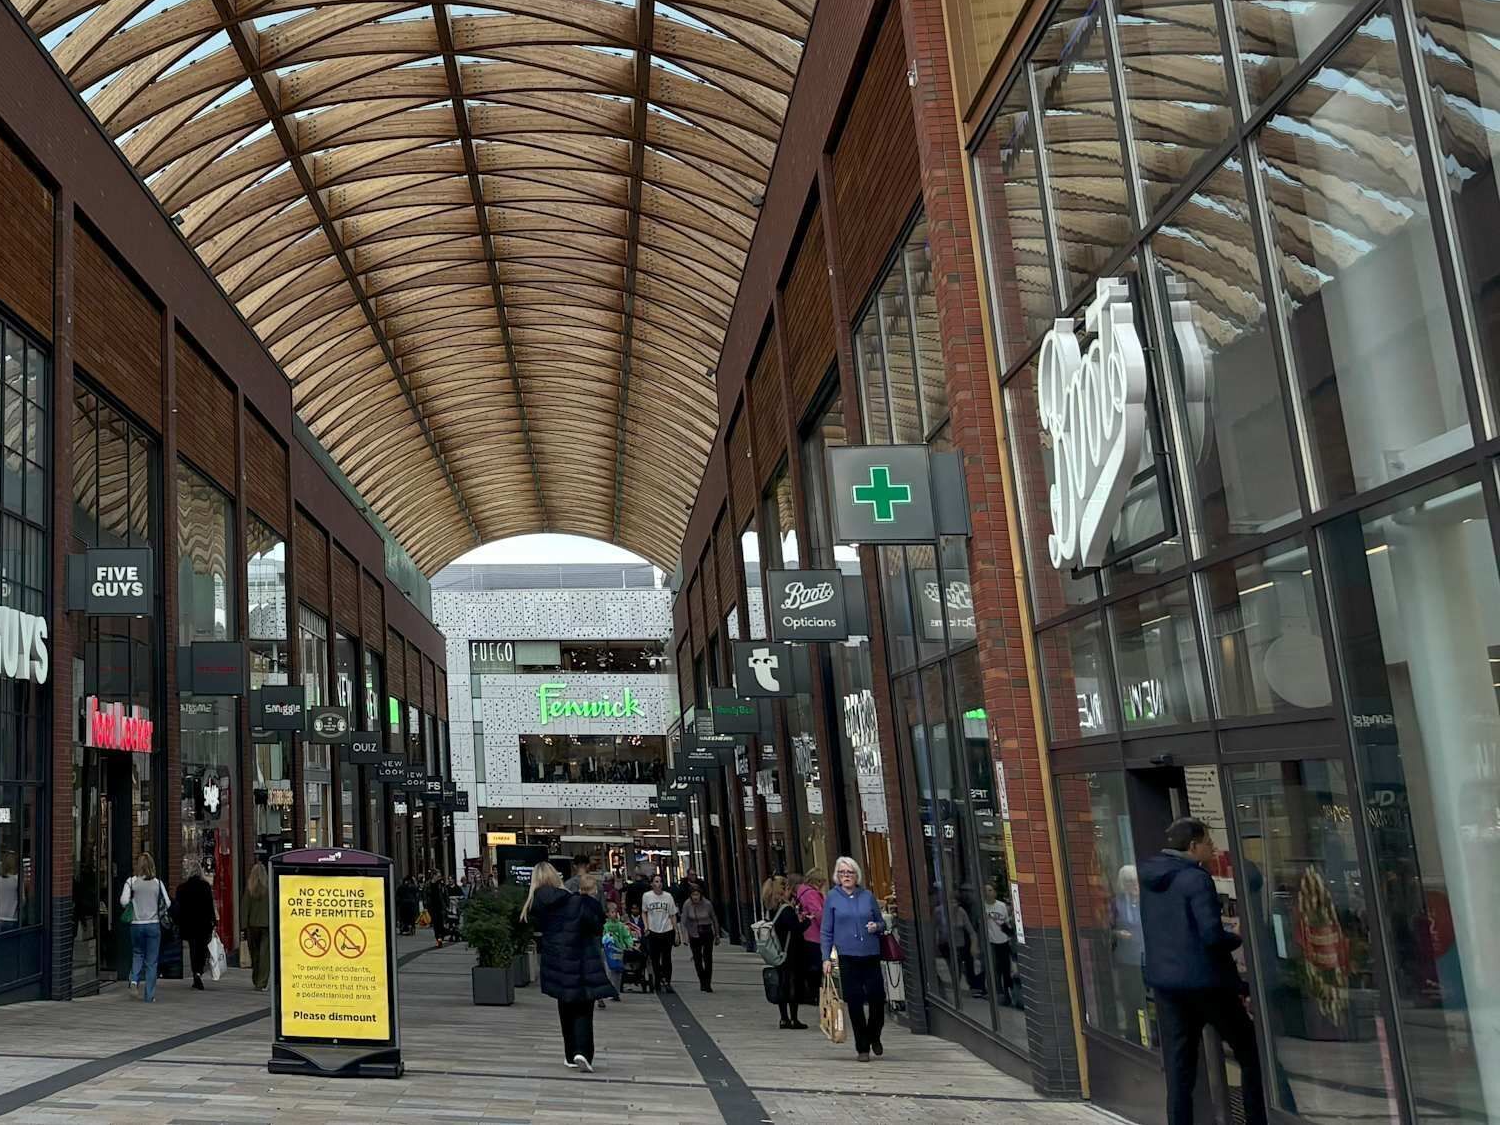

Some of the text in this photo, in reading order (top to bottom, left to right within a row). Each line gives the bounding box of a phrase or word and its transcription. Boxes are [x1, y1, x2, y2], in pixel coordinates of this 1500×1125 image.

[1038, 277, 1146, 570] Boots
[96, 566, 138, 581] FIVE
[91, 582, 144, 597] GUYS
[781, 582, 835, 610] Boots
[782, 617, 838, 629] Opticians
[472, 642, 513, 662] FUEGO
[536, 683, 645, 725] Fenwick
[353, 742, 377, 752] QUIZ
[426, 782, 441, 790] FS
[299, 888, 364, 897] NO CYCLING
[287, 898, 374, 908] OR E-SCOOTERS
[291, 908, 375, 918] ARE PERMITTED
[293, 1011, 376, 1022] Please dismount
